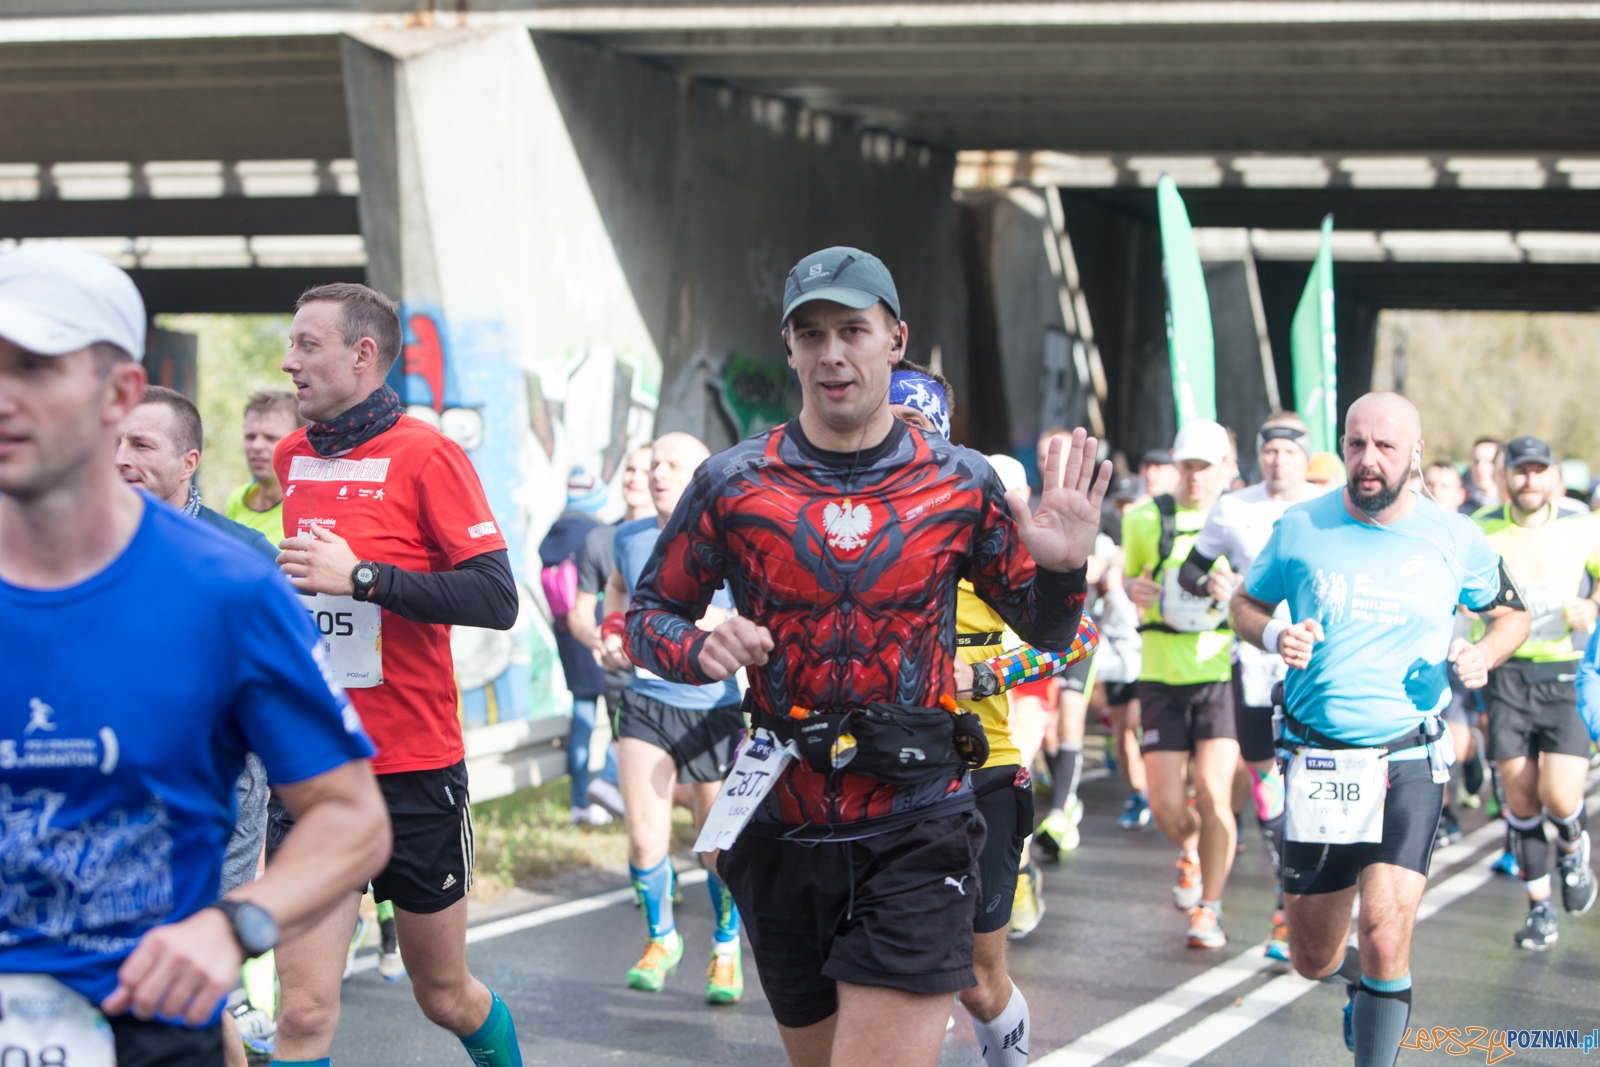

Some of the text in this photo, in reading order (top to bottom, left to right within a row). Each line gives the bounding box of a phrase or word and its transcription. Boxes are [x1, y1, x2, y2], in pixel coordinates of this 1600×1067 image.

[1352, 597, 1400, 612] PHILIPS
[308, 610, 353, 636] 05
[1307, 760, 1335, 769] 17.PKO
[1308, 781, 1360, 801] 2318
